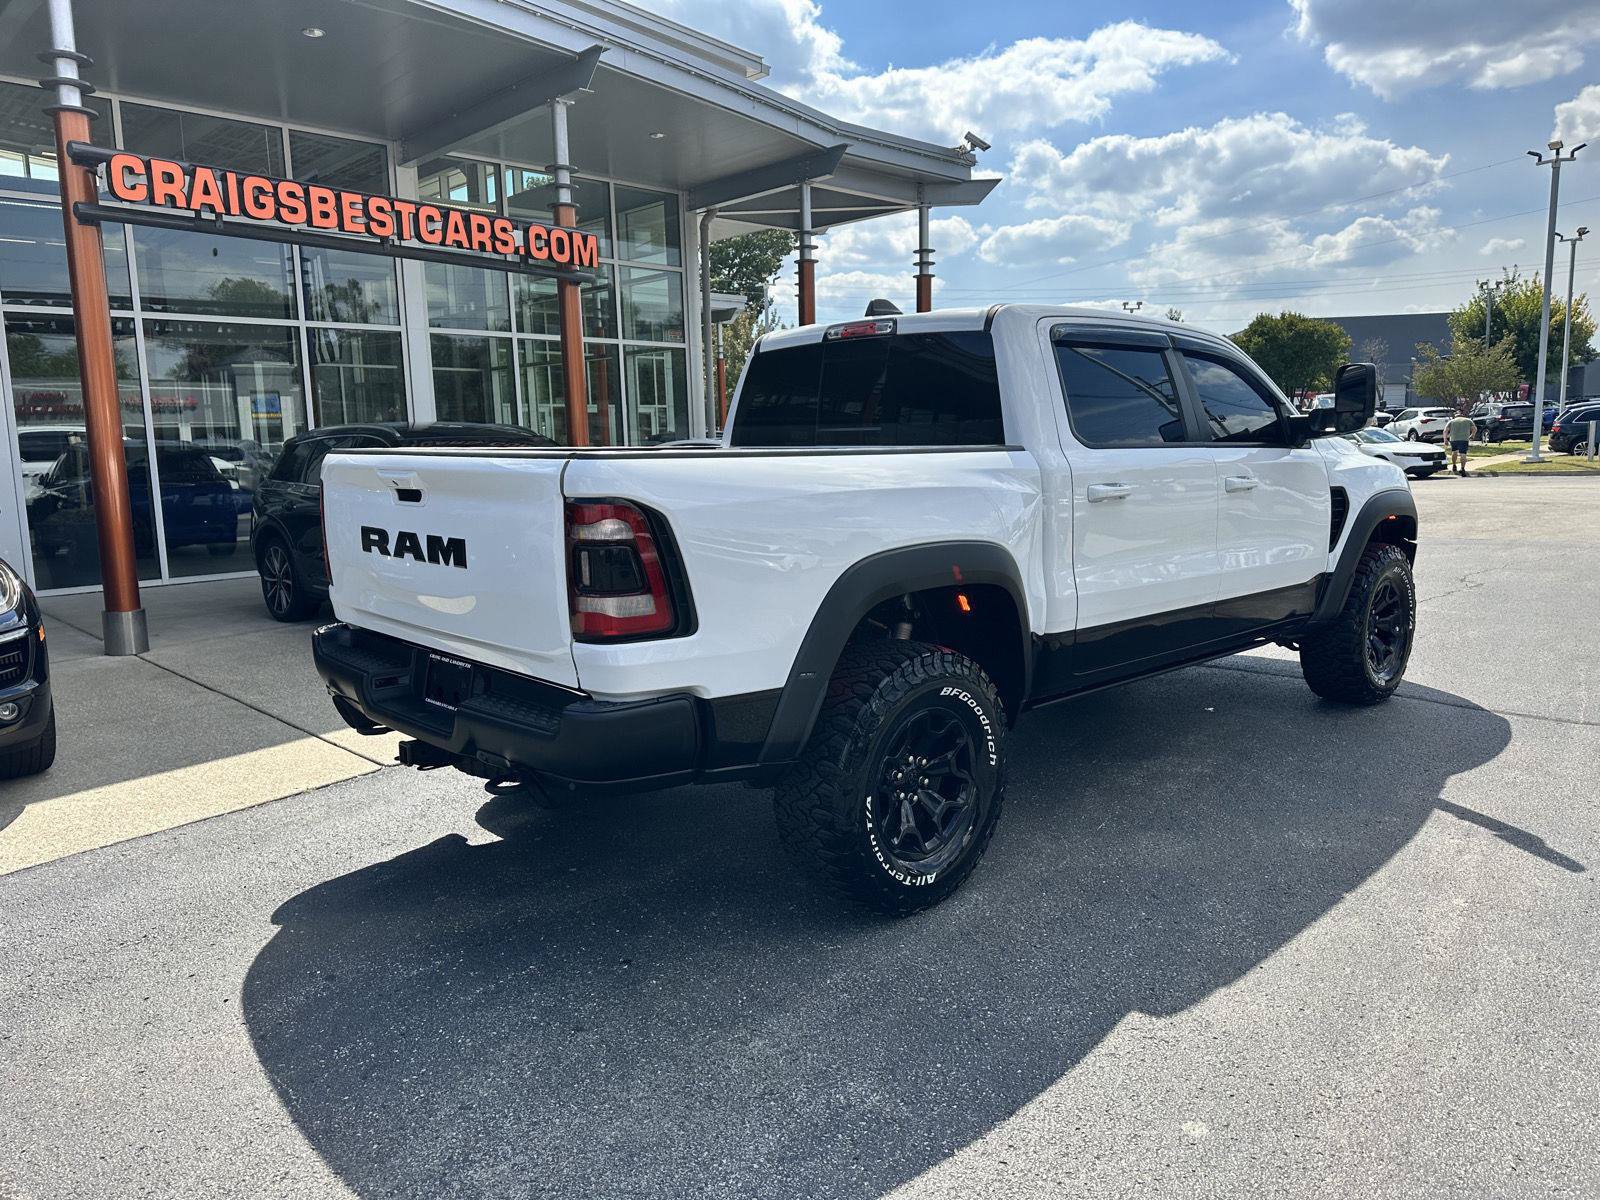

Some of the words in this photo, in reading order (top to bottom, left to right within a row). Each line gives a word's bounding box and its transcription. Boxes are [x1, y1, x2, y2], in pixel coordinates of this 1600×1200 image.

[108, 152, 598, 269] CRAIGSBESTCARS.COM
[361, 525, 467, 569] RAM
[939, 686, 998, 767] BFGoodrich
[865, 796, 873, 831] T/A
[869, 835, 938, 886] All-Terrain
